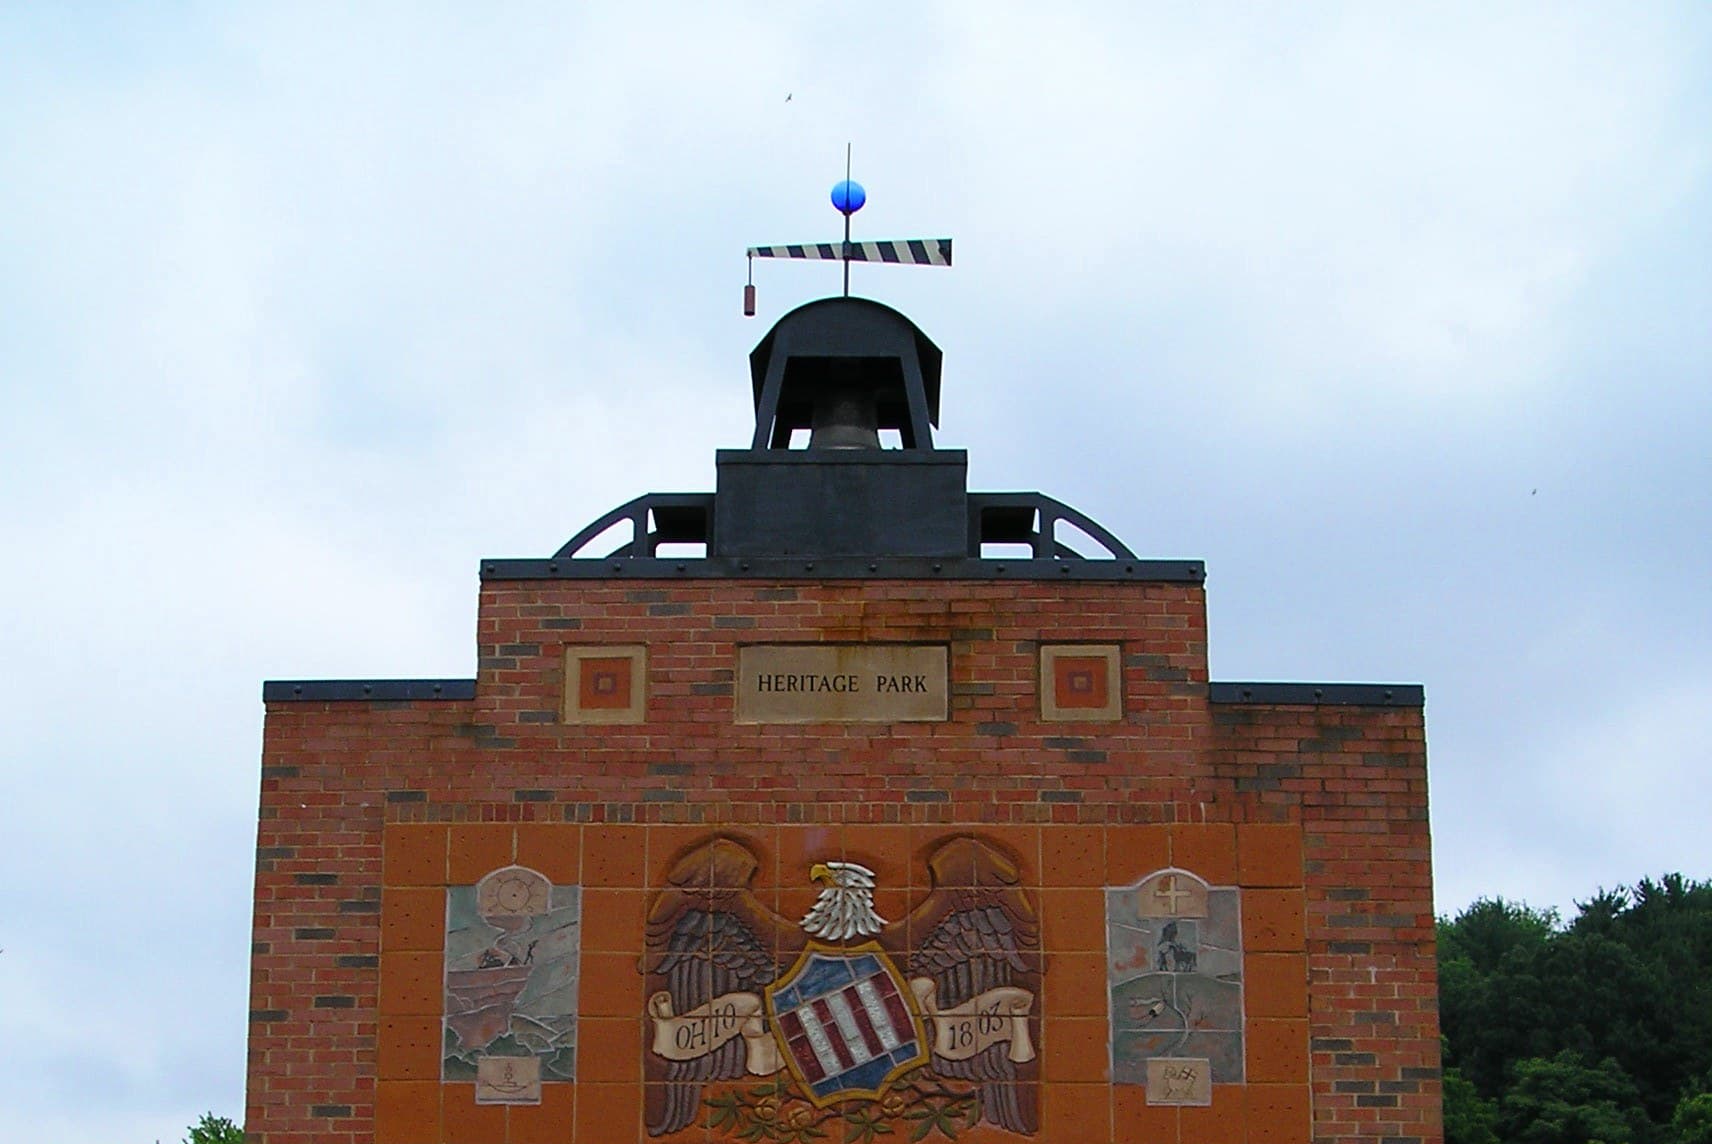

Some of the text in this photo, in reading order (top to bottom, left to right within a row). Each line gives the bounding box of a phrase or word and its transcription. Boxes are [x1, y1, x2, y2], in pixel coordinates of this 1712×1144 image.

[757, 674, 928, 693] HERITAGE PARK
[676, 1003, 736, 1049] OHIO
[949, 1000, 1003, 1050] 1803
